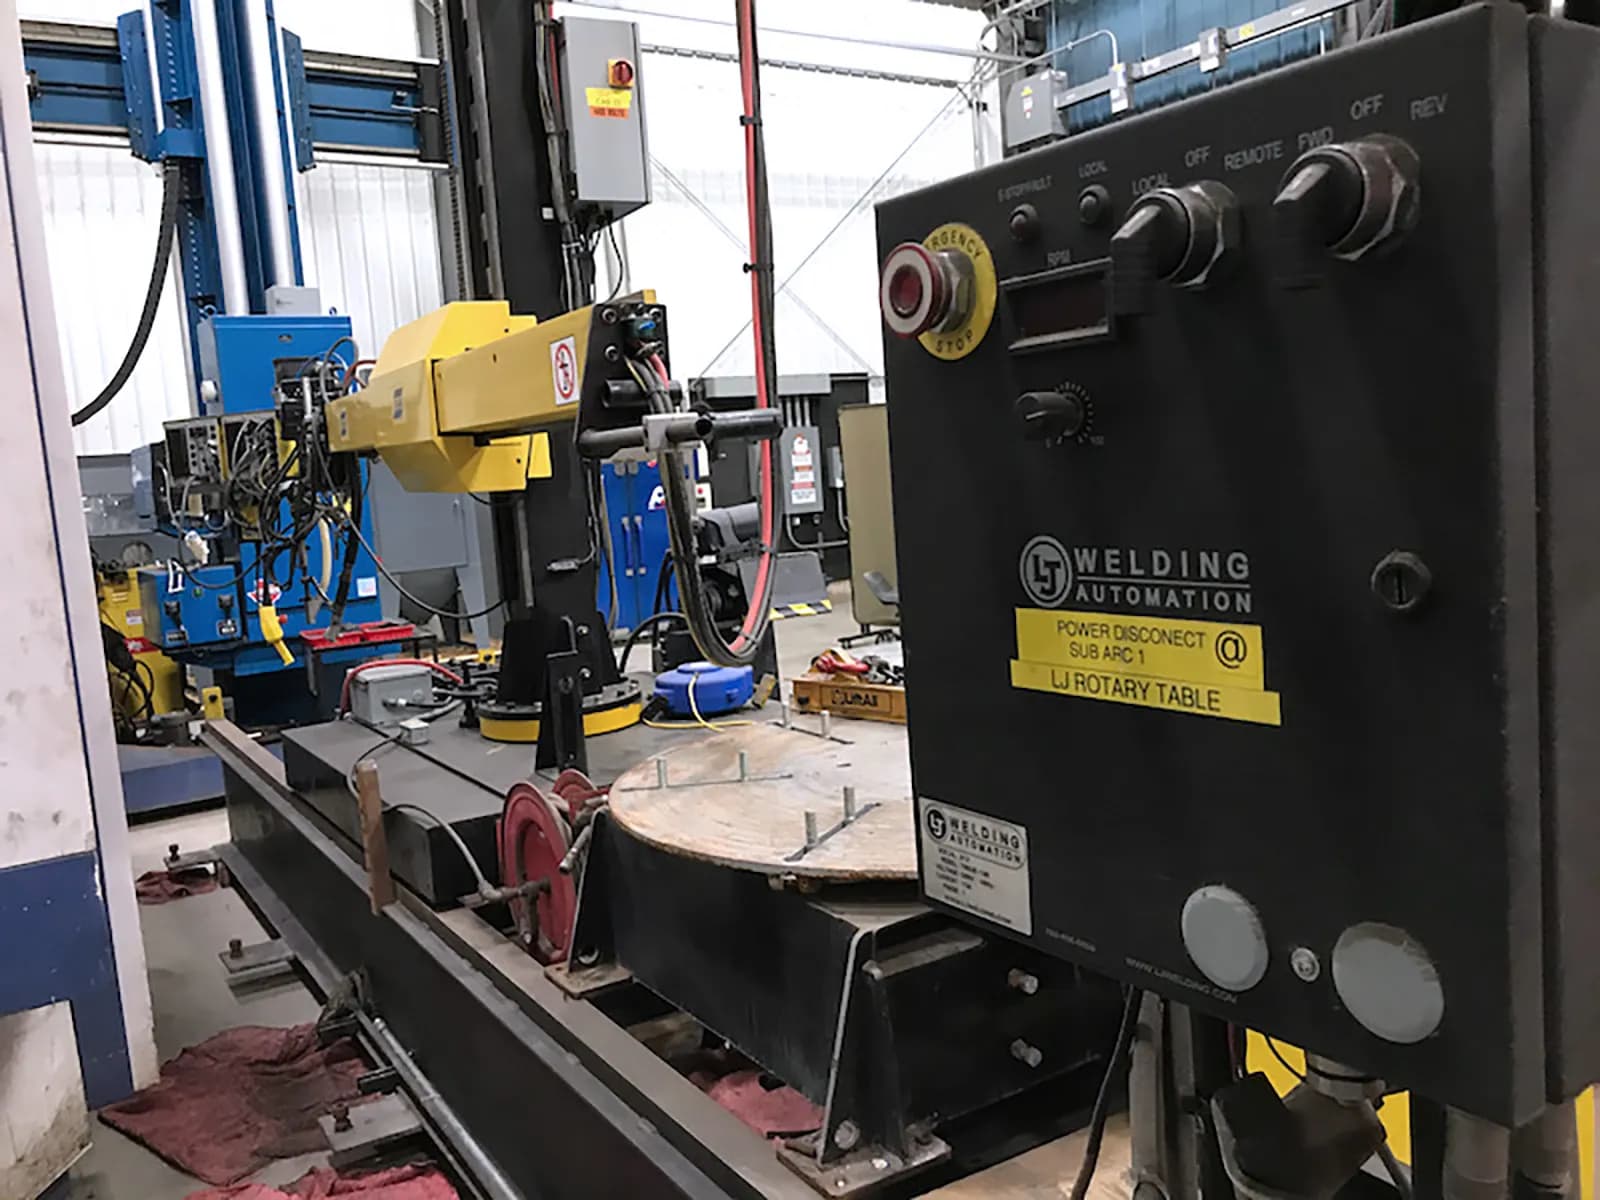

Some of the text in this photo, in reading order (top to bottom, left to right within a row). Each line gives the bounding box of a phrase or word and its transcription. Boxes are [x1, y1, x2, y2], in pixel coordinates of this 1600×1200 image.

[1351, 94, 1384, 120] OFF
[1410, 93, 1448, 120] REV
[1298, 126, 1334, 150] FWD
[1184, 146, 1211, 168] OFF
[1224, 140, 1284, 171] REMOTE
[1132, 172, 1171, 195] LOCAL
[935, 329, 973, 353] STOP
[1074, 548, 1250, 580] WELDING
[1076, 583, 1251, 613] AUTOMATION
[1057, 619, 1206, 649] POWER DISCONECT
[1069, 641, 1146, 665] SUB ARC 1
[1051, 669, 1221, 712] LJ ROTARY TABLE
[950, 817, 1020, 849] WELDING
[949, 834, 1021, 864] AUTOMATION
